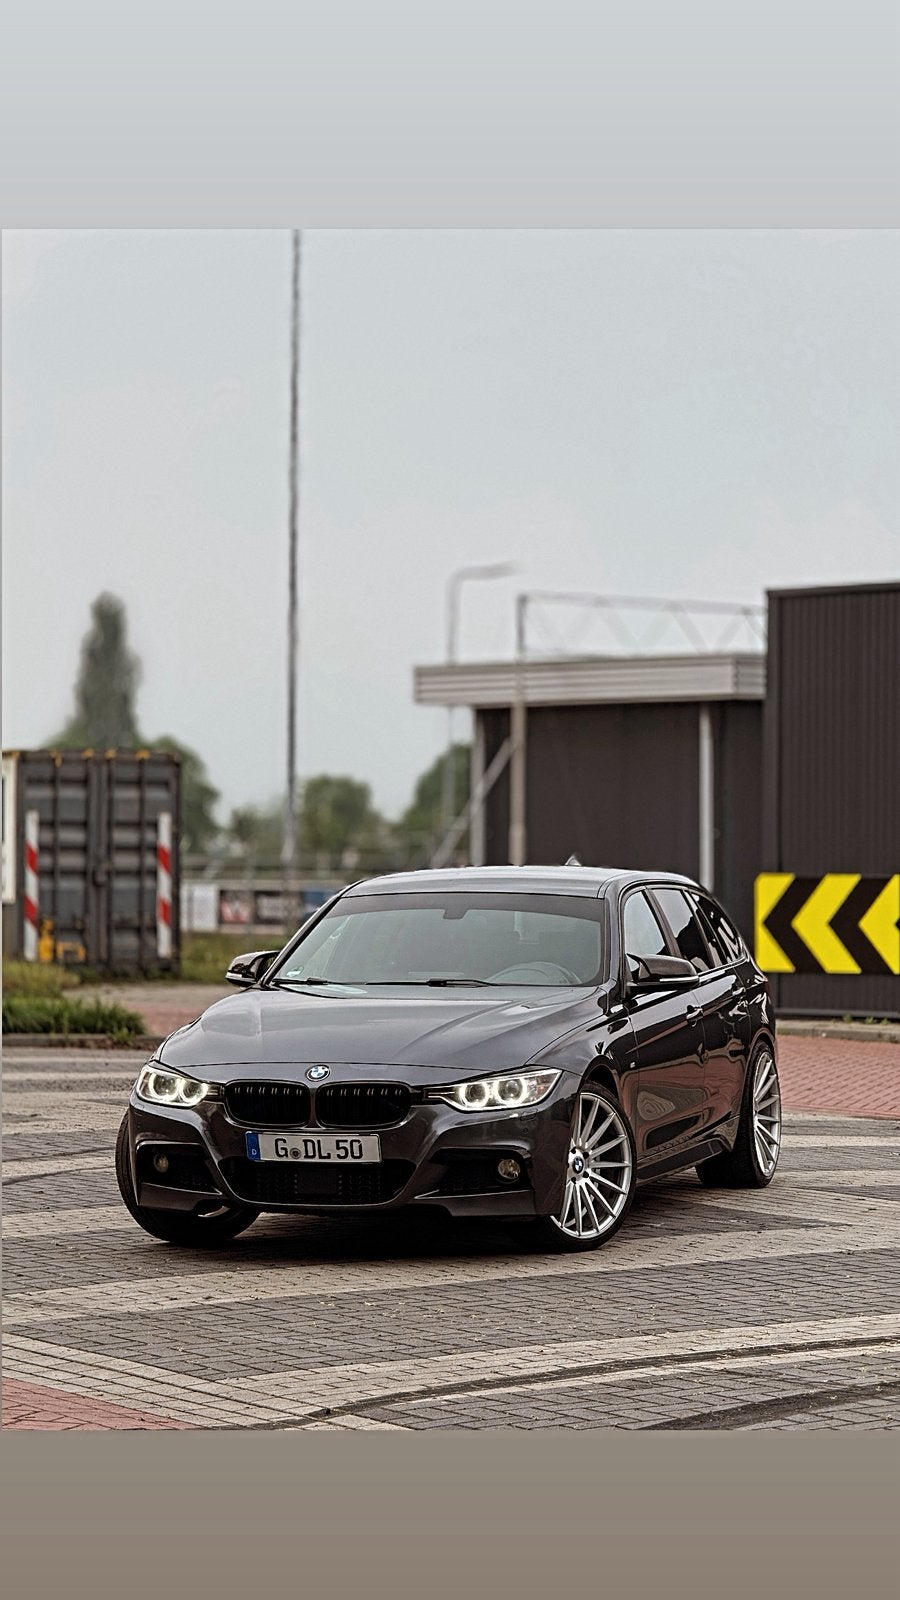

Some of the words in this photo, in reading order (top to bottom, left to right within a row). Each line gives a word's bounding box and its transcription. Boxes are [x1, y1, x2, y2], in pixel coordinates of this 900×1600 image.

[251, 1148, 258, 1156] D
[274, 1138, 289, 1158] G
[302, 1139, 332, 1159] DL
[335, 1139, 364, 1159] 50
